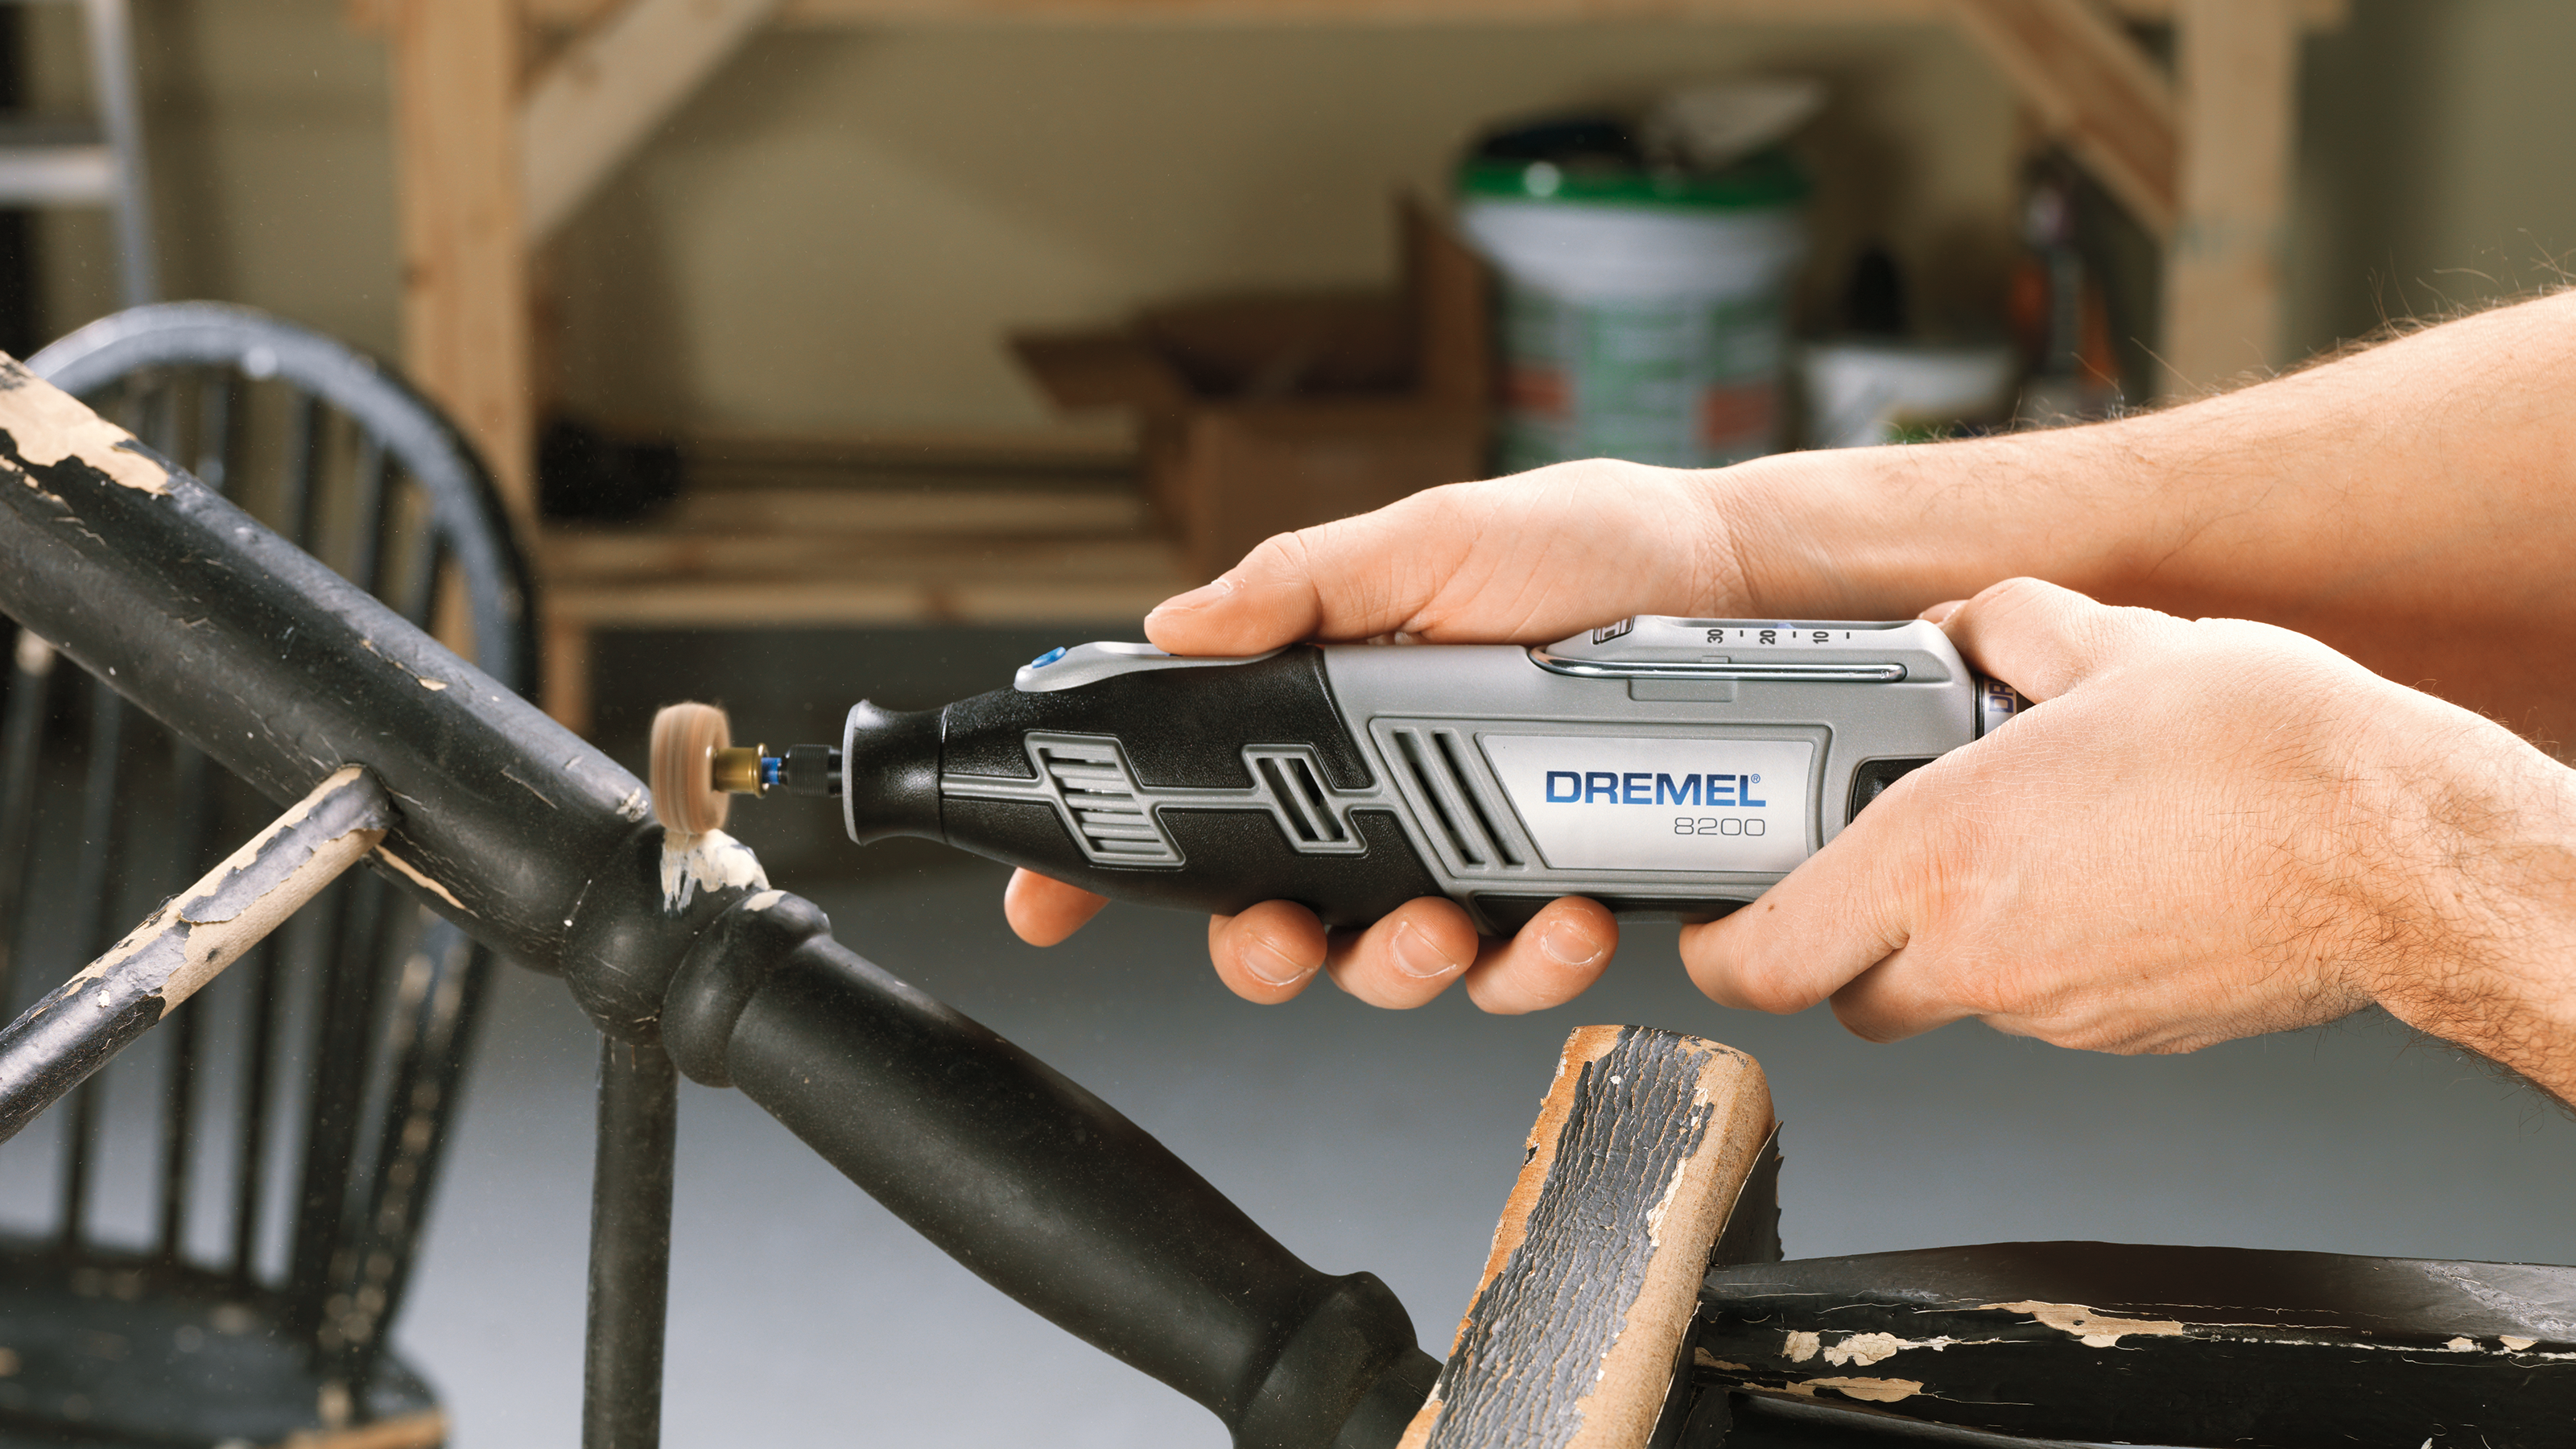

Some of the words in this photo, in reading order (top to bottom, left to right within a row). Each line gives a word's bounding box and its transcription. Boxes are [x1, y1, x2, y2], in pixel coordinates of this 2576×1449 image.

[1707, 629, 1724, 644] 30
[1759, 630, 1777, 646] 20
[1812, 630, 1830, 645] 10
[1988, 679, 2014, 713] DR
[1674, 817, 1766, 836] 8200
